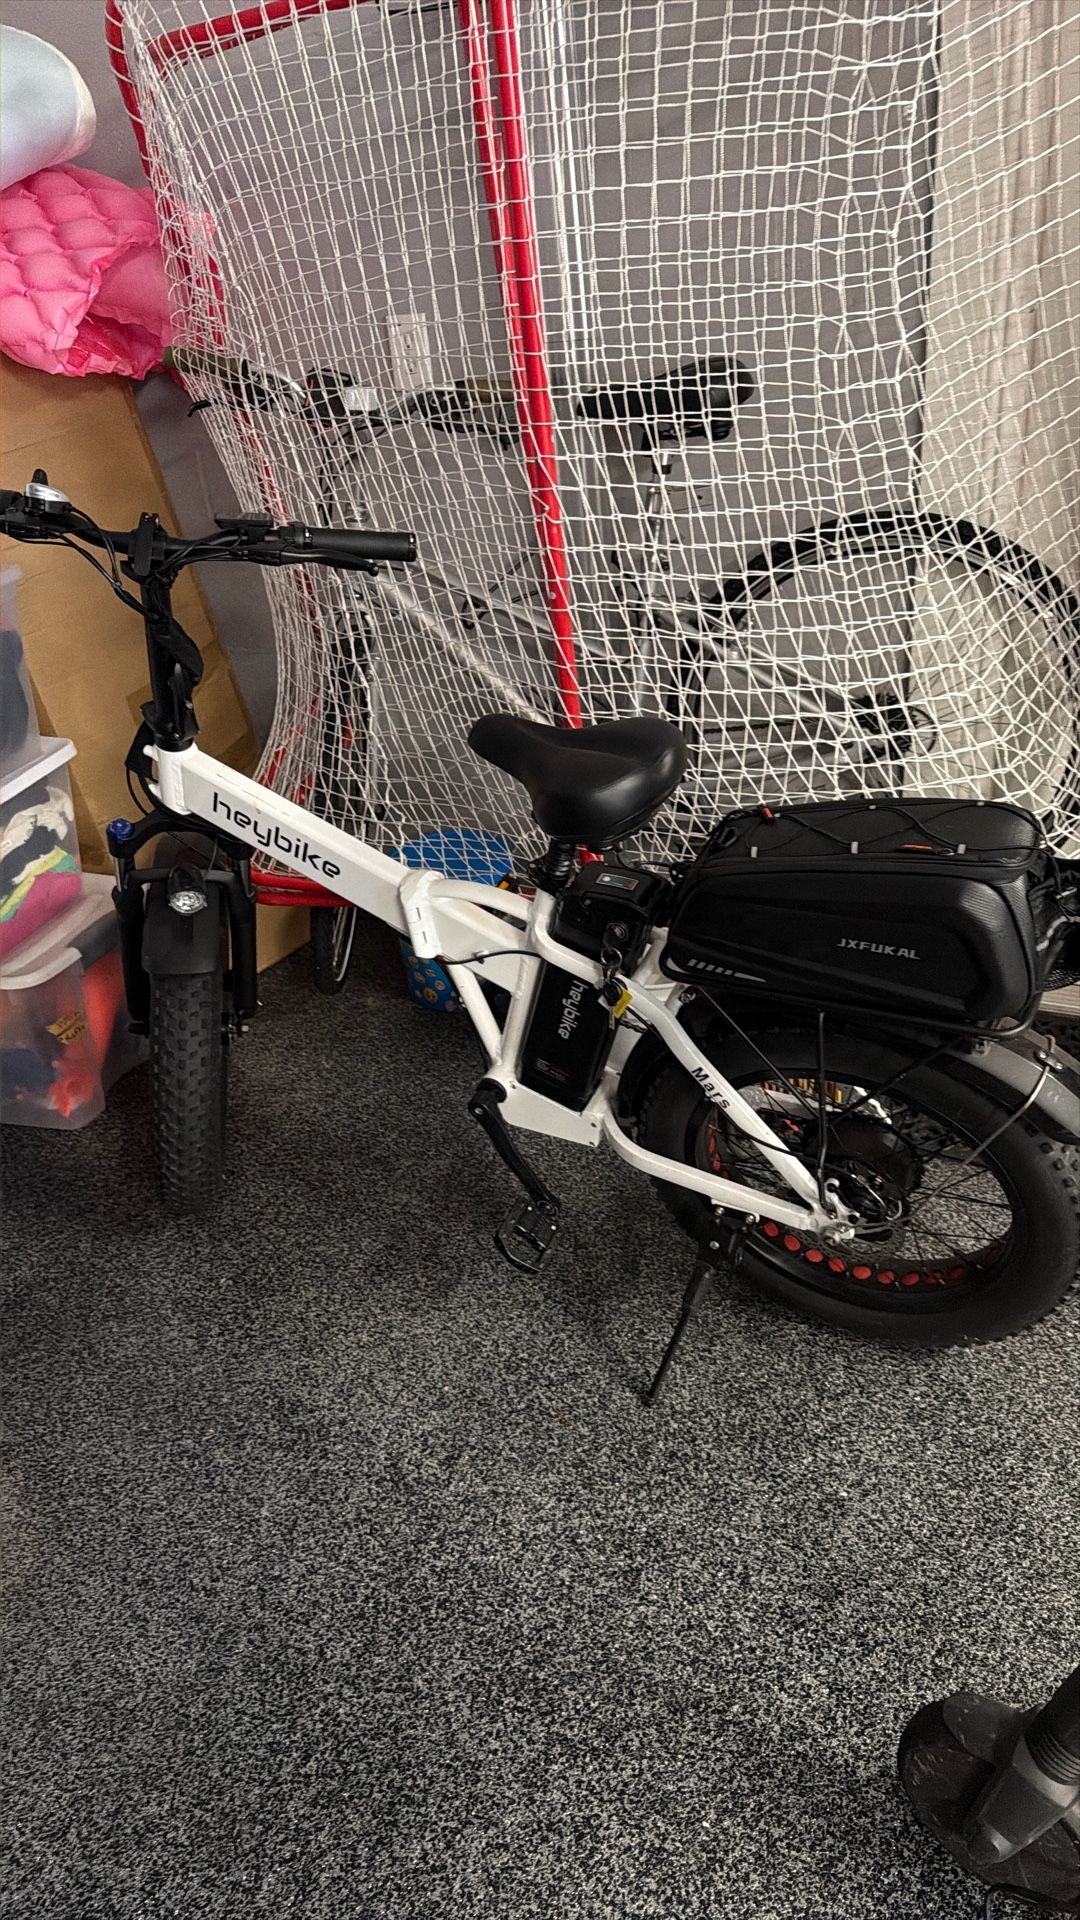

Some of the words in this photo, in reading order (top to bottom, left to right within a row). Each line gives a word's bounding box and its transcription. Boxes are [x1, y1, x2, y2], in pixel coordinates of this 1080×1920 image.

[212, 791, 341, 879] heybike
[836, 938, 921, 960] JXFUKAL
[557, 979, 589, 1039] heybike
[691, 1066, 730, 1109] Mars
